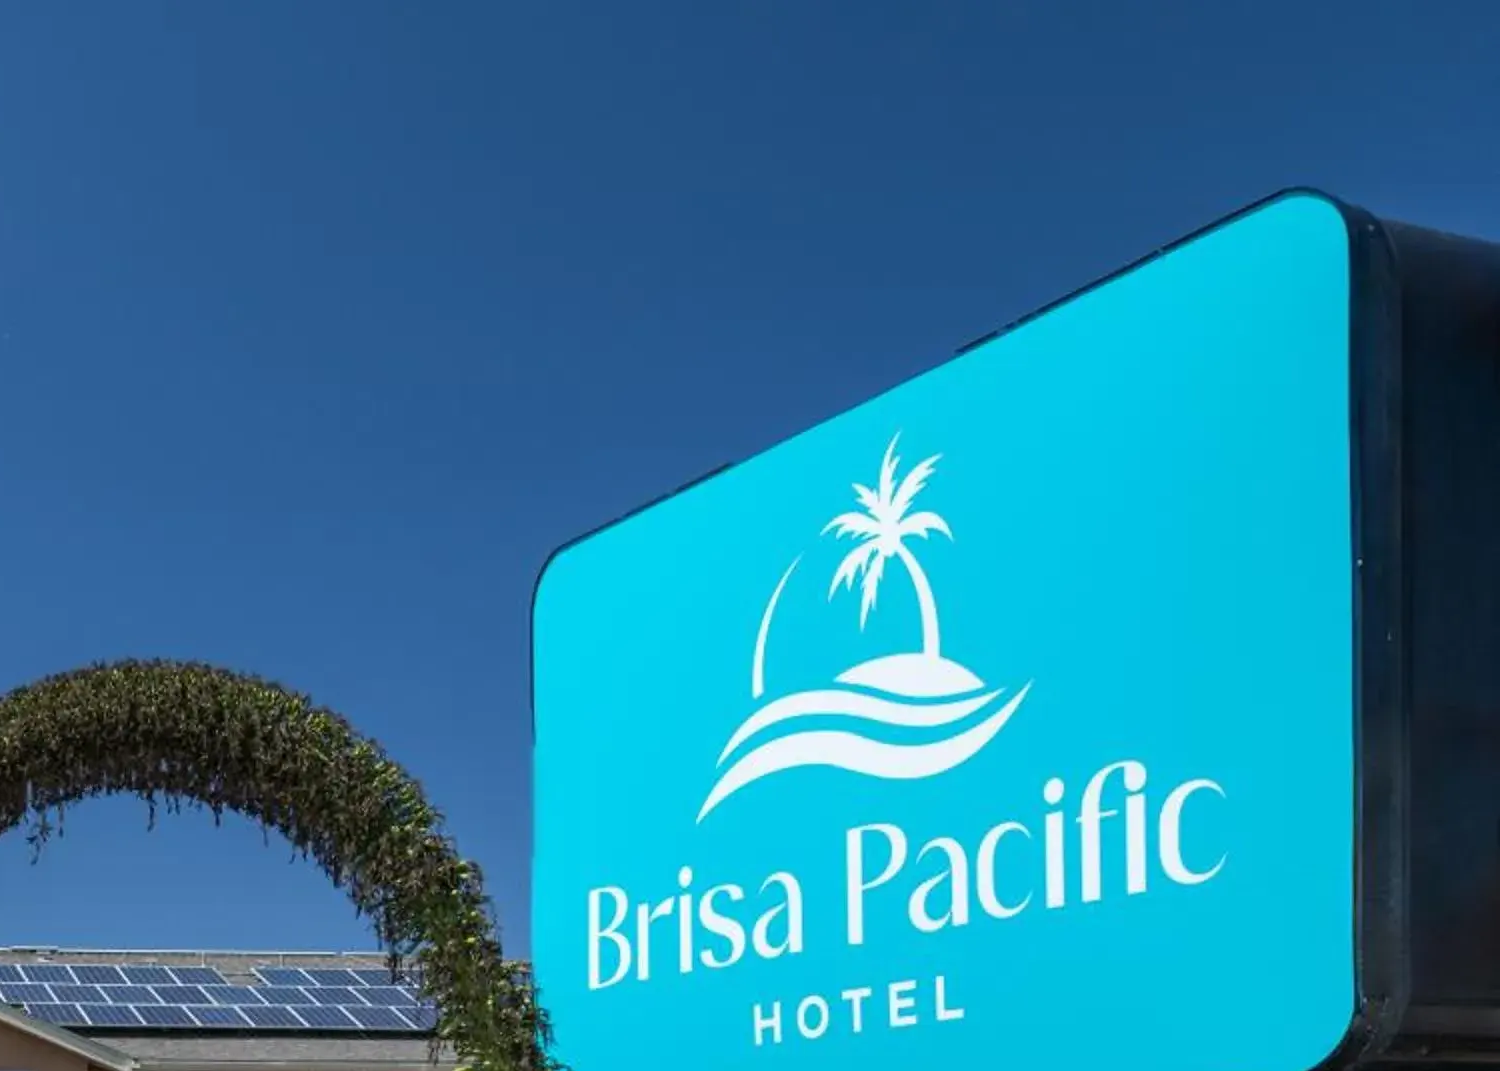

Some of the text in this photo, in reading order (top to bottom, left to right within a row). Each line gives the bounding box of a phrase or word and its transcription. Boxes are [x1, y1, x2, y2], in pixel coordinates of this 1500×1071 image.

[588, 760, 1227, 989] Brisa Pacific
[753, 976, 965, 1045] HOTEL
